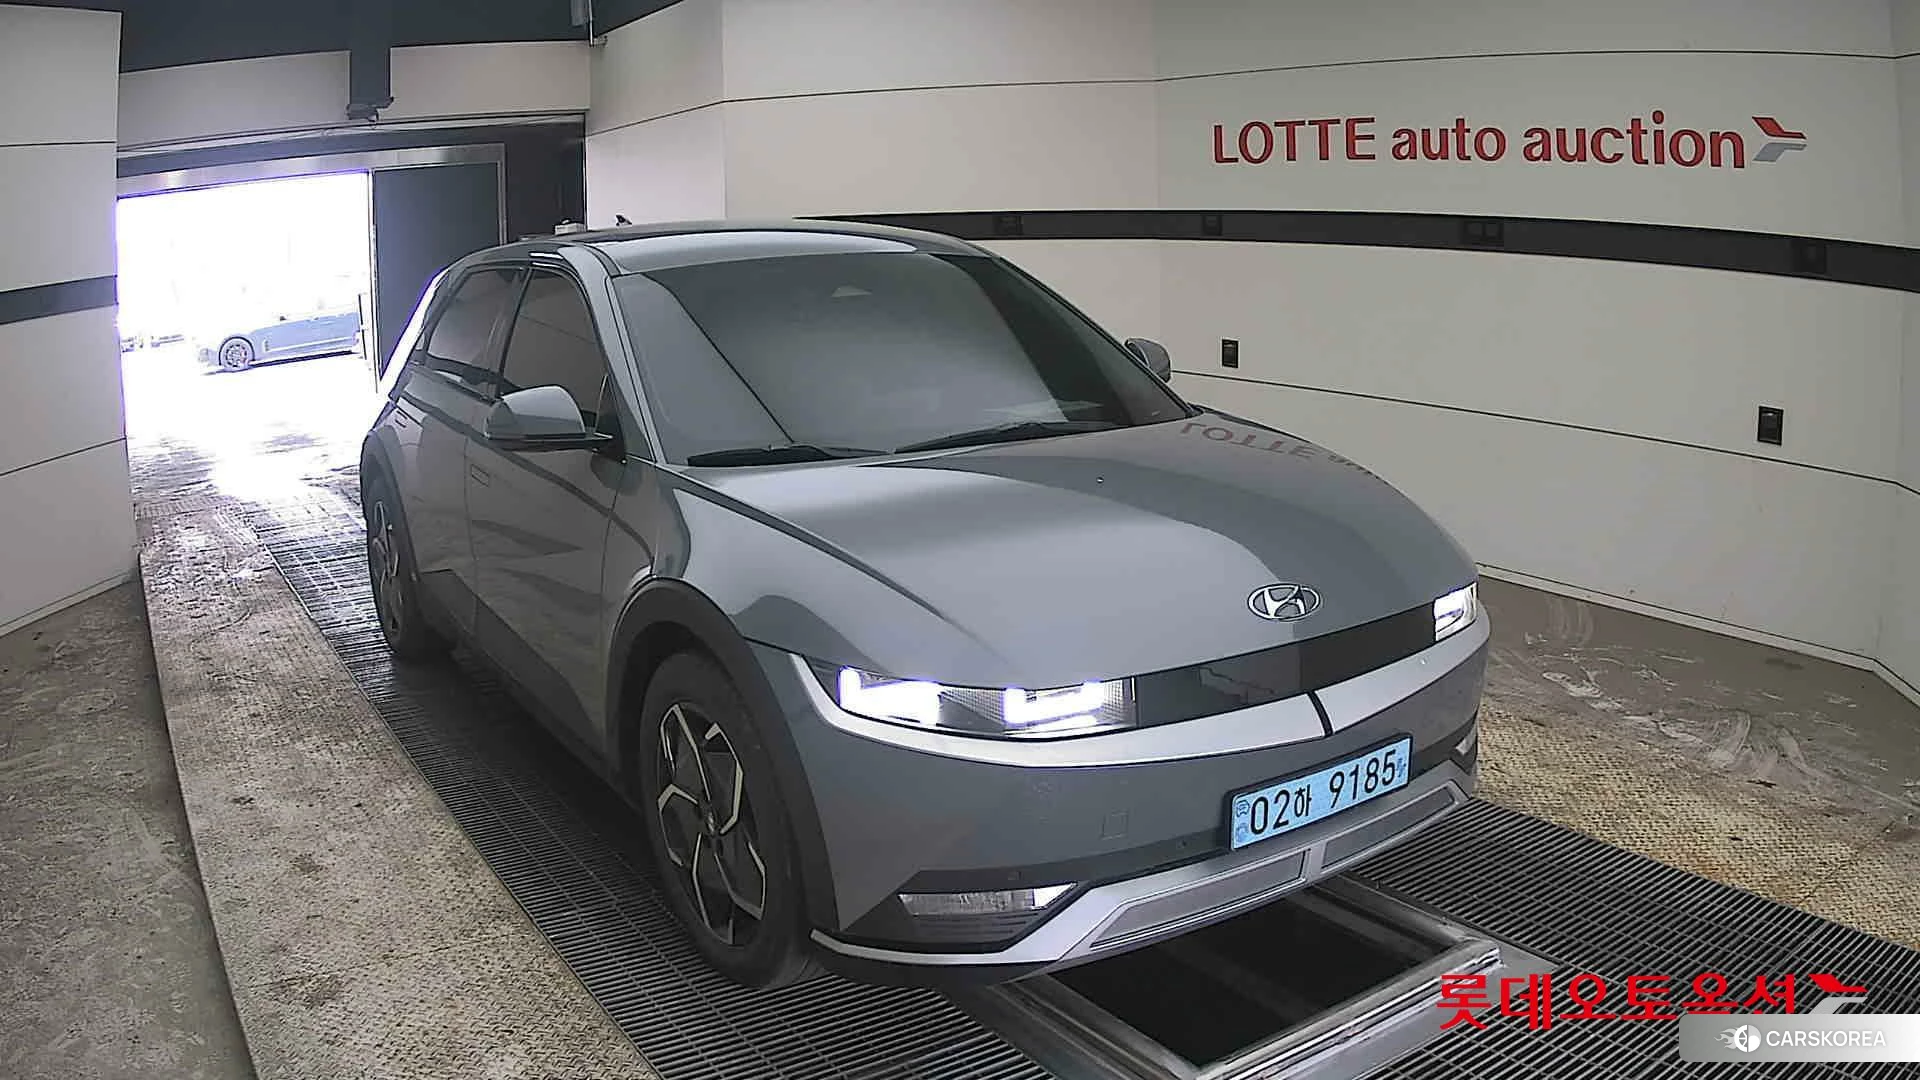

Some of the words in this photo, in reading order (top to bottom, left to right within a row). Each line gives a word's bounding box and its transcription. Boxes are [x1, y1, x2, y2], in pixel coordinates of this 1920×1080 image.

[1212, 116, 1376, 164] LOTTE
[1391, 117, 1506, 162] auto
[1522, 110, 1745, 168] auction
[1250, 783, 1312, 835] 02하
[1329, 749, 1397, 809] 9185
